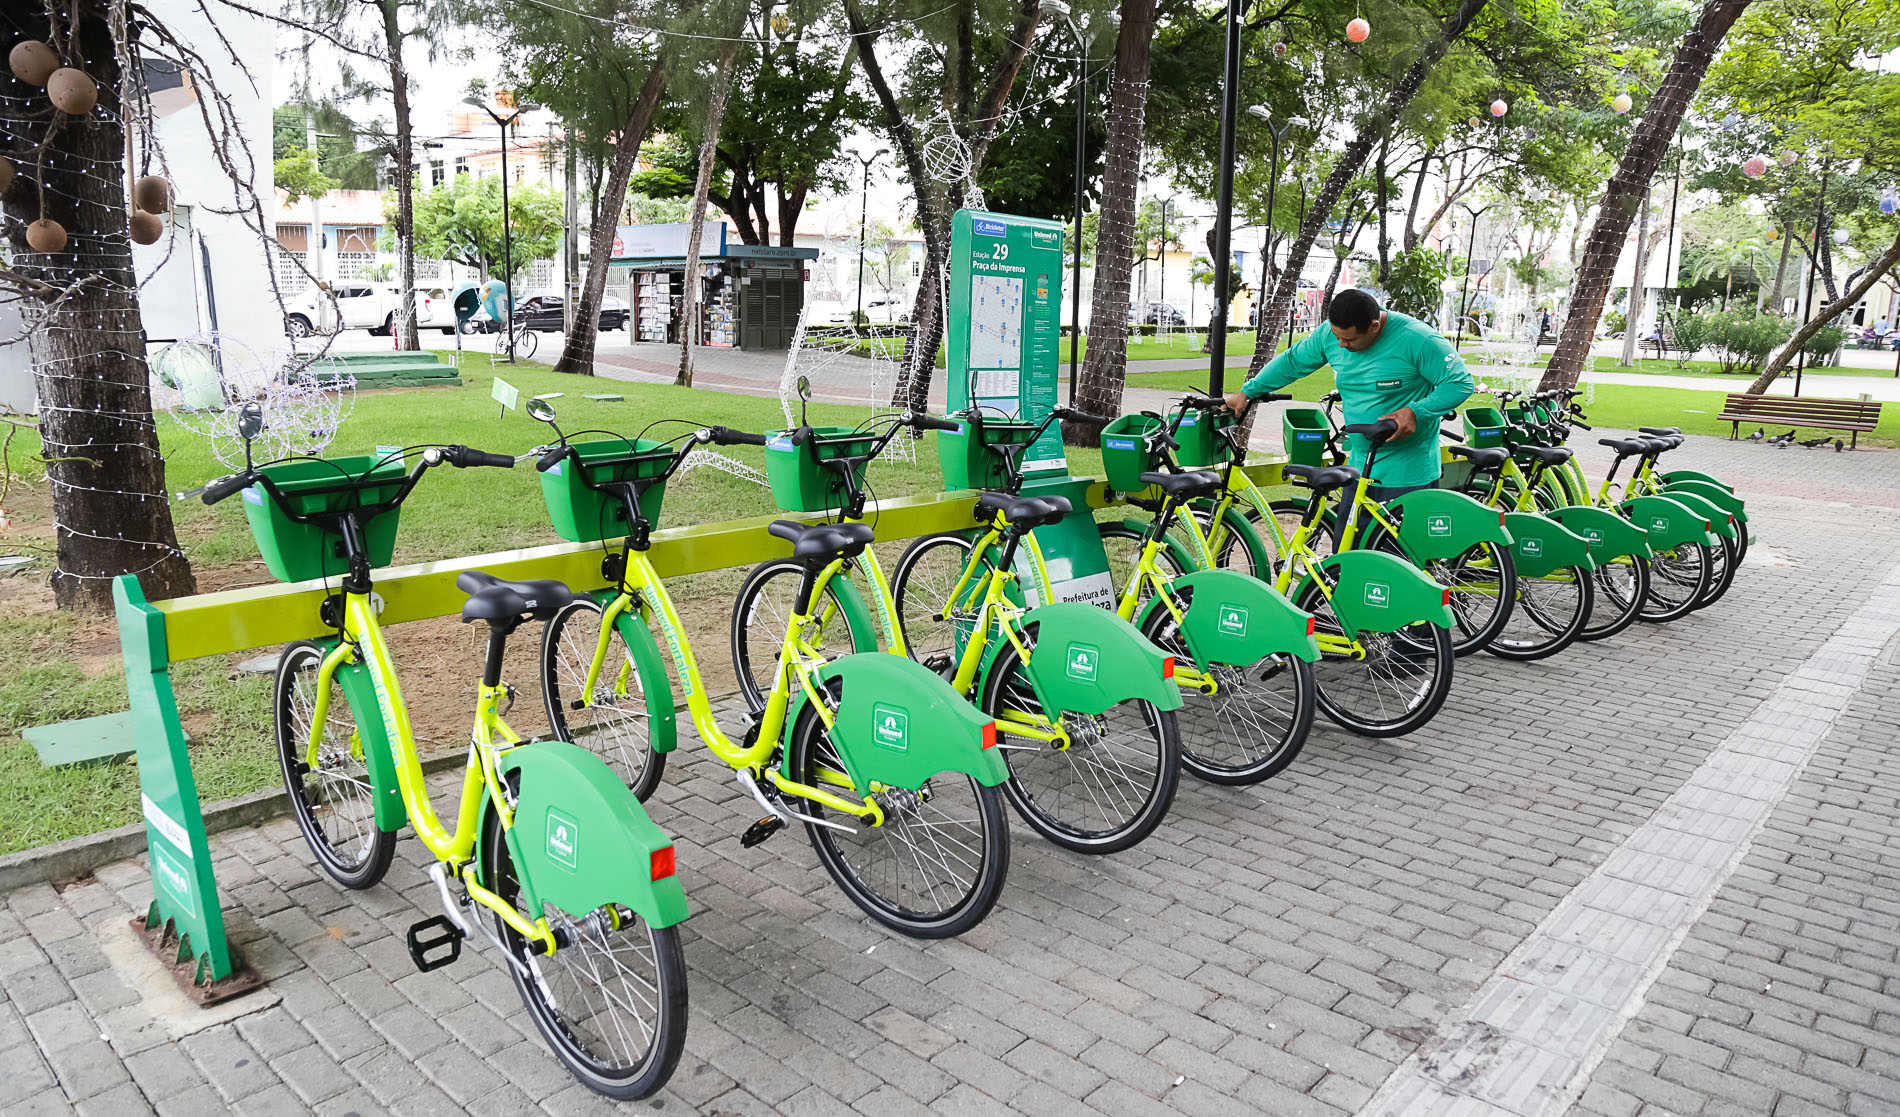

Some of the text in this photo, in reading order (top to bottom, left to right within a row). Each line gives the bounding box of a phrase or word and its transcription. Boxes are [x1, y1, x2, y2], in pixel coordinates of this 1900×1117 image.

[973, 243, 1009, 260] Estação 29
[973, 261, 1025, 274] Praça da Imprensa
[1063, 587, 1109, 603] Prefeitura de
[875, 592, 894, 649] Fortaleza
[1222, 619, 1243, 629] Unimed
[645, 583, 693, 696] Unimed Fortaleza
[1071, 661, 1094, 673] Unimed
[377, 691, 402, 768] Fortaleza
[879, 725, 903, 738] Unimed
[550, 835, 573, 854] Unimed
